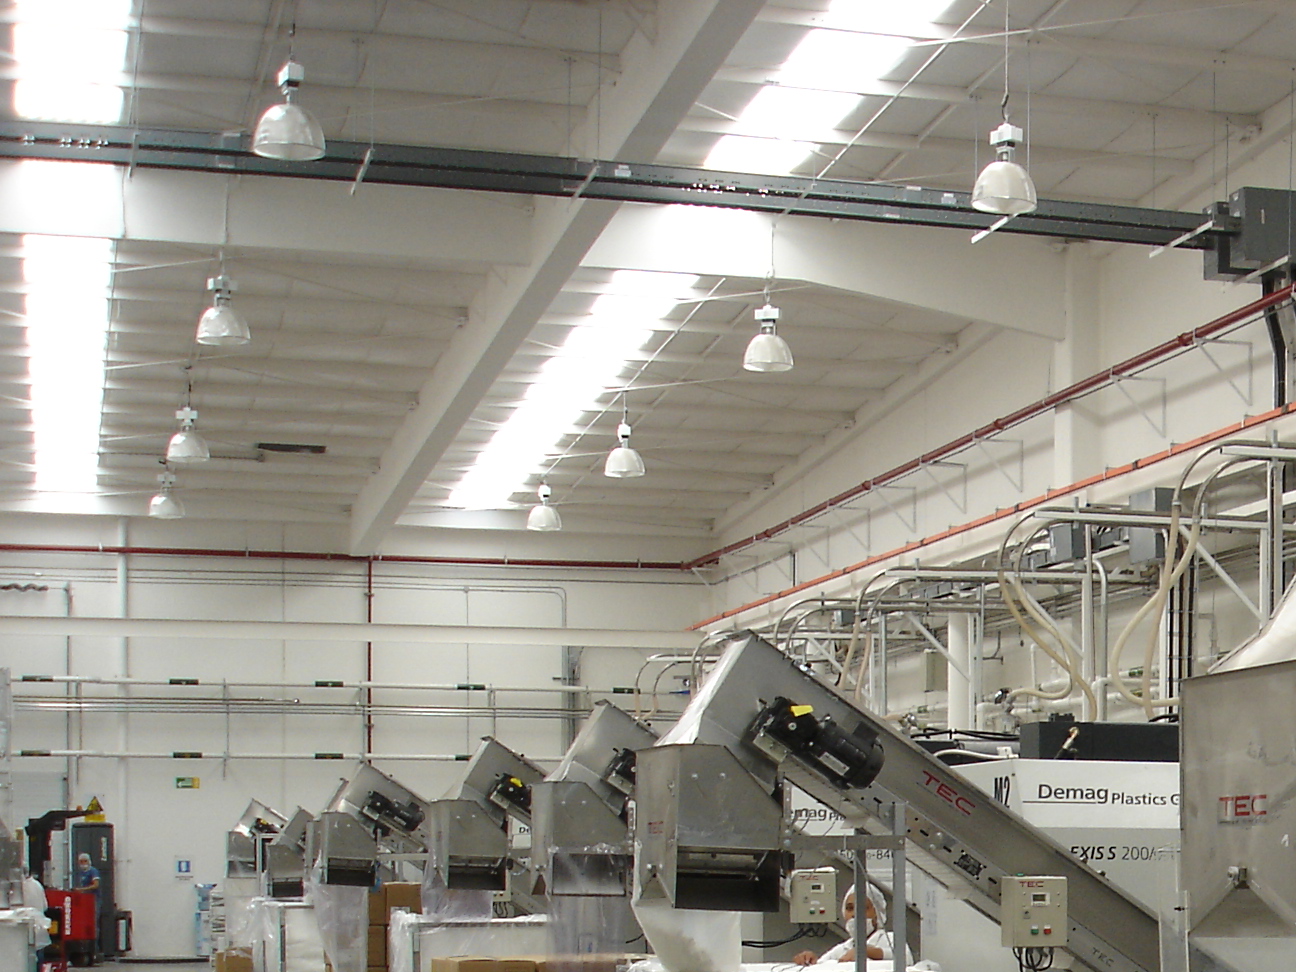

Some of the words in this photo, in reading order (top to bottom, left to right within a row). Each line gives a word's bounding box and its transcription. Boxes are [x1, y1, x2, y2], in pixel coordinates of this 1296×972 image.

[922, 770, 976, 816] TEC
[1038, 784, 1109, 804] Demag
[1111, 791, 1167, 806] Plastics
[1218, 794, 1267, 816] TEC
[1107, 846, 1117, 860] S
